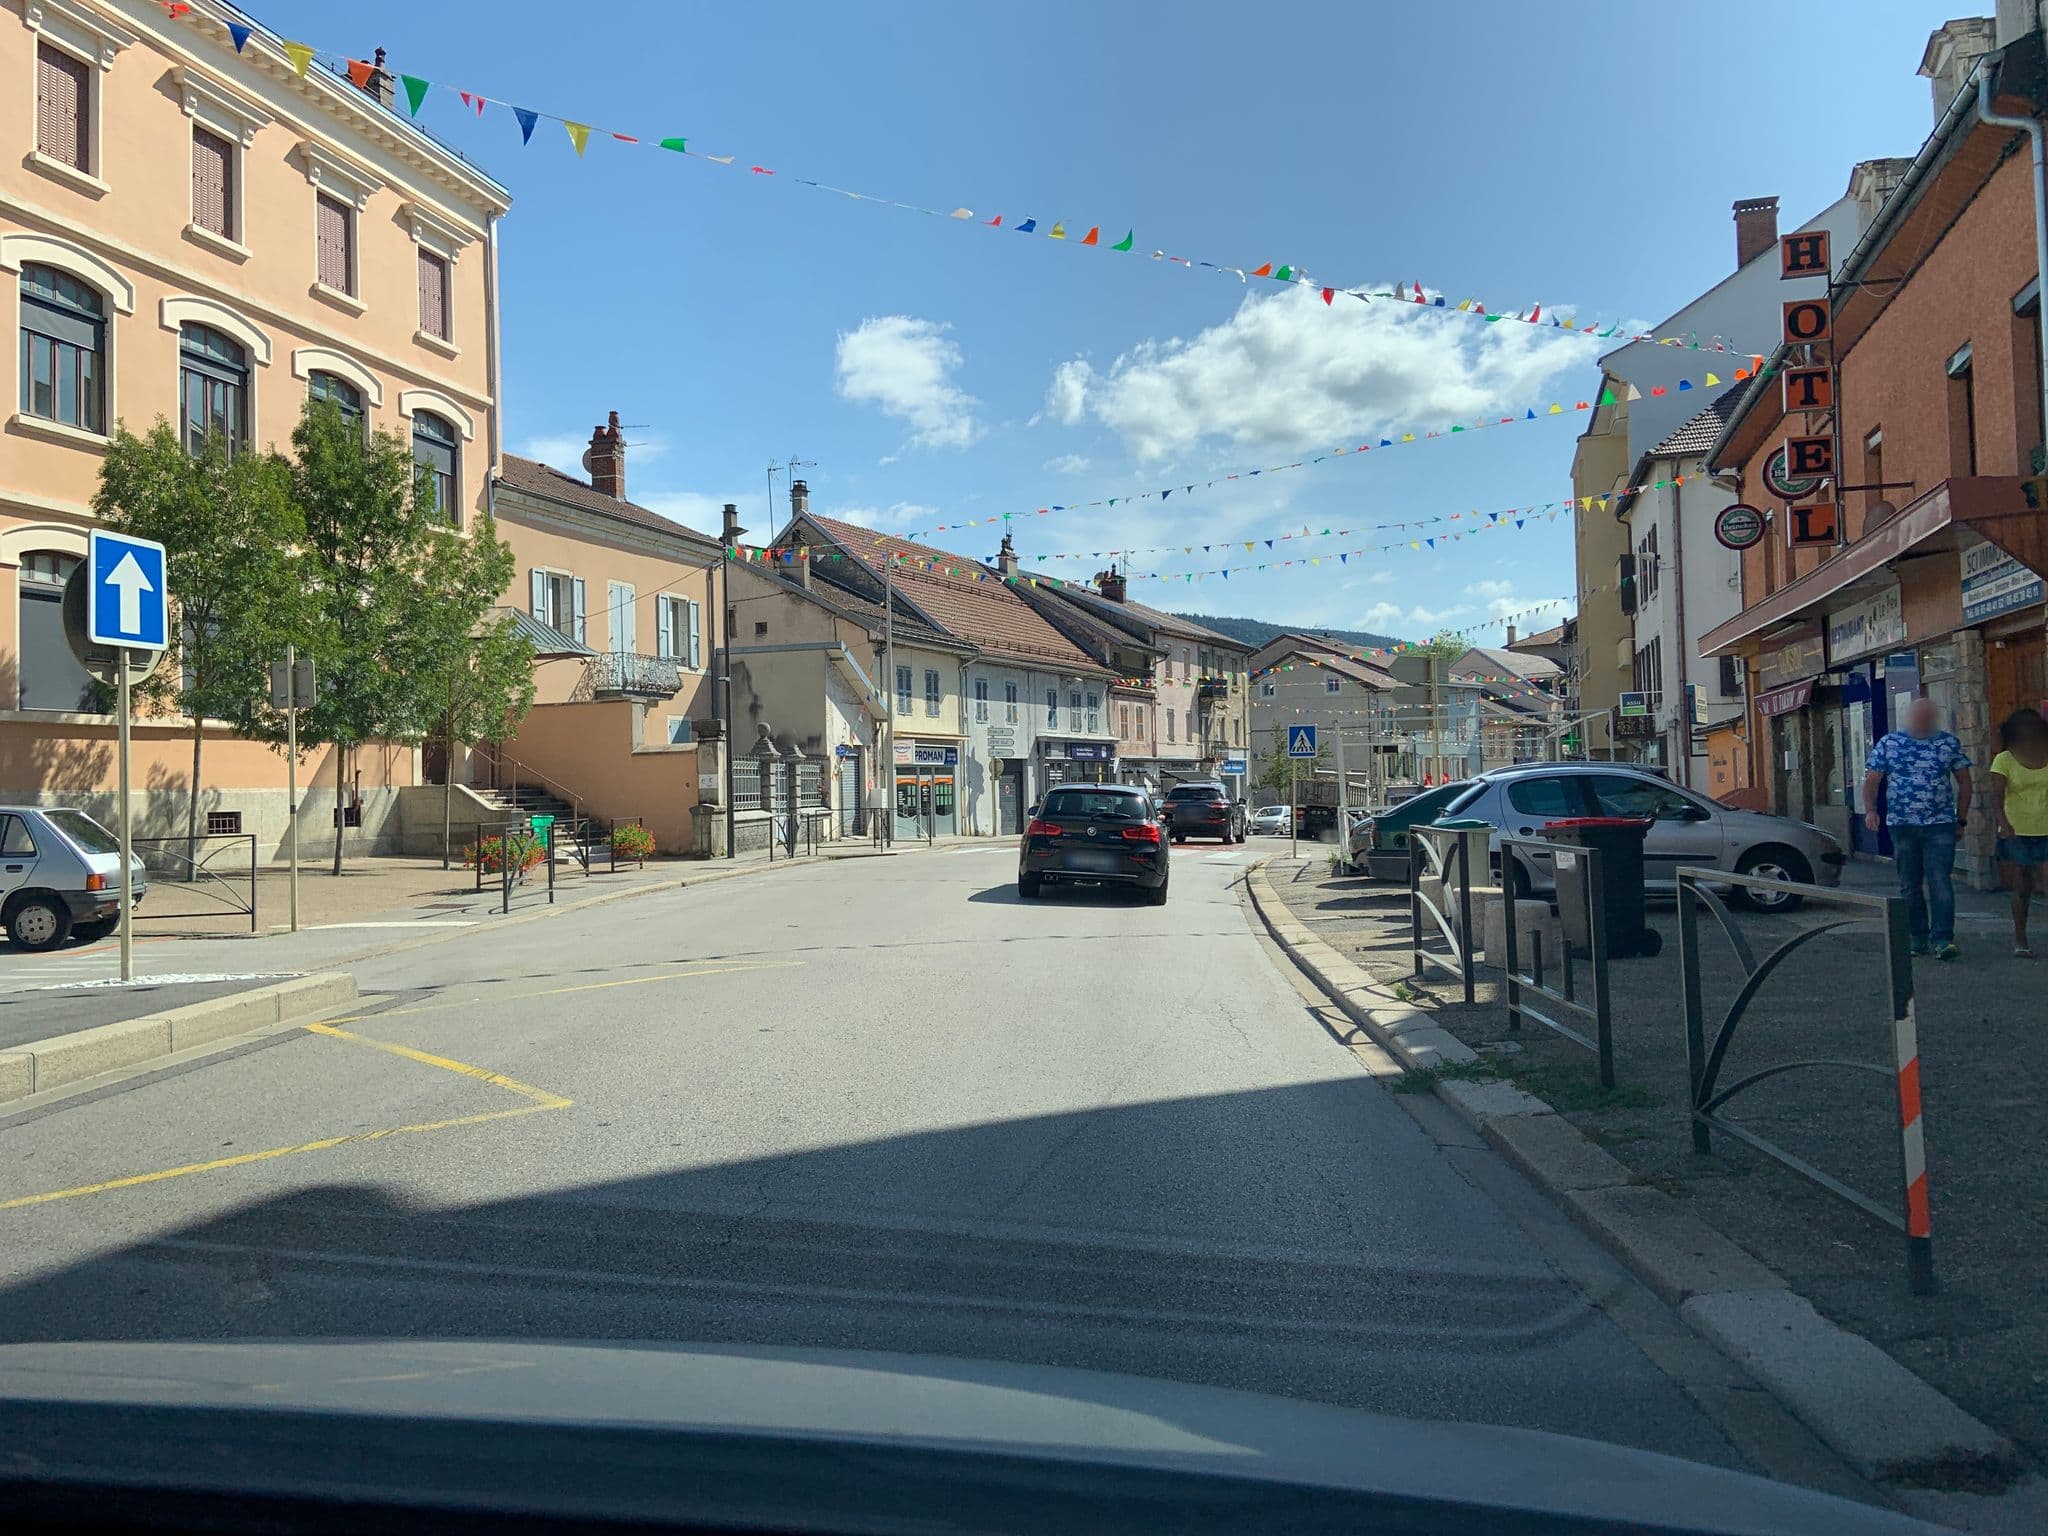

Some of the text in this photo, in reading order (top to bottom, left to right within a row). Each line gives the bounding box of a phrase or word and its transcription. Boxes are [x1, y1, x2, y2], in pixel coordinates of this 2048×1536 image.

[1785, 234, 1835, 543] HOTEL
[1722, 520, 1759, 532] Heineken
[915, 750, 943, 761] PROMAN
